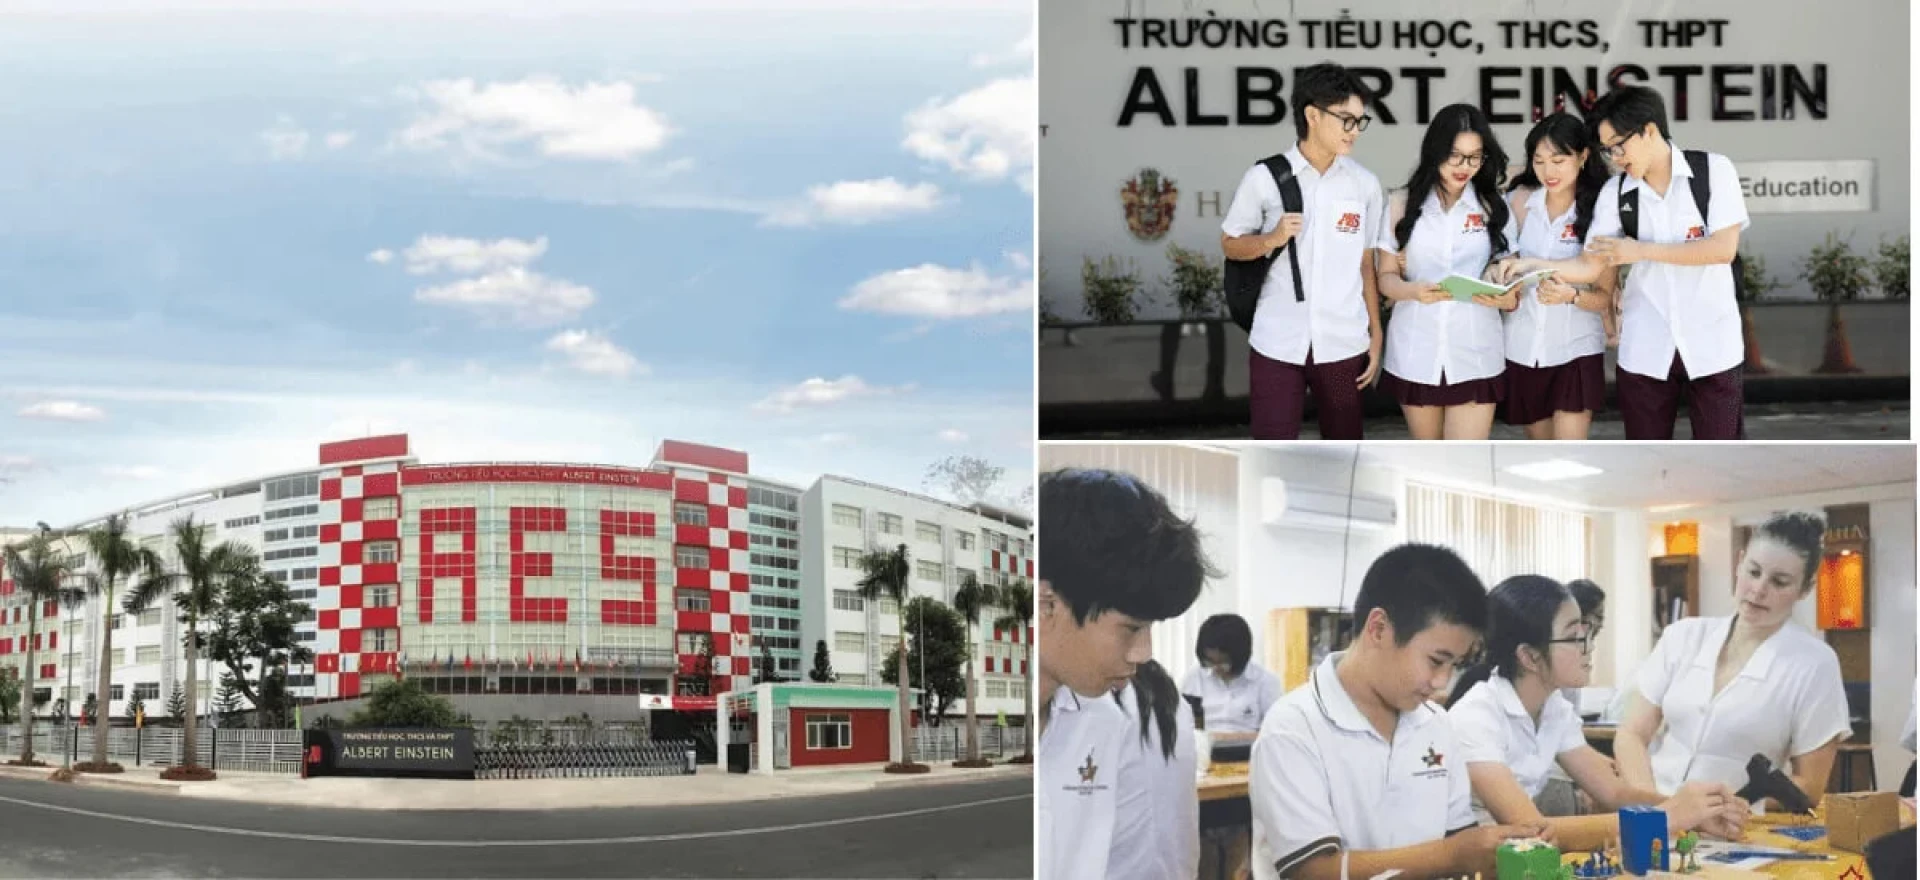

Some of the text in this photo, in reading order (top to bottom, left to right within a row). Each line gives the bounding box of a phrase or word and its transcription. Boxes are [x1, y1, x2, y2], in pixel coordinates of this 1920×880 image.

[1112, 8, 1730, 58] TRƯỜNG TIỂU HỌC, THCS, THPT
[1117, 65, 1446, 126] ALBRT
[1738, 176, 1859, 198] Education
[342, 745, 454, 759] ALBERT EINSTEIN
